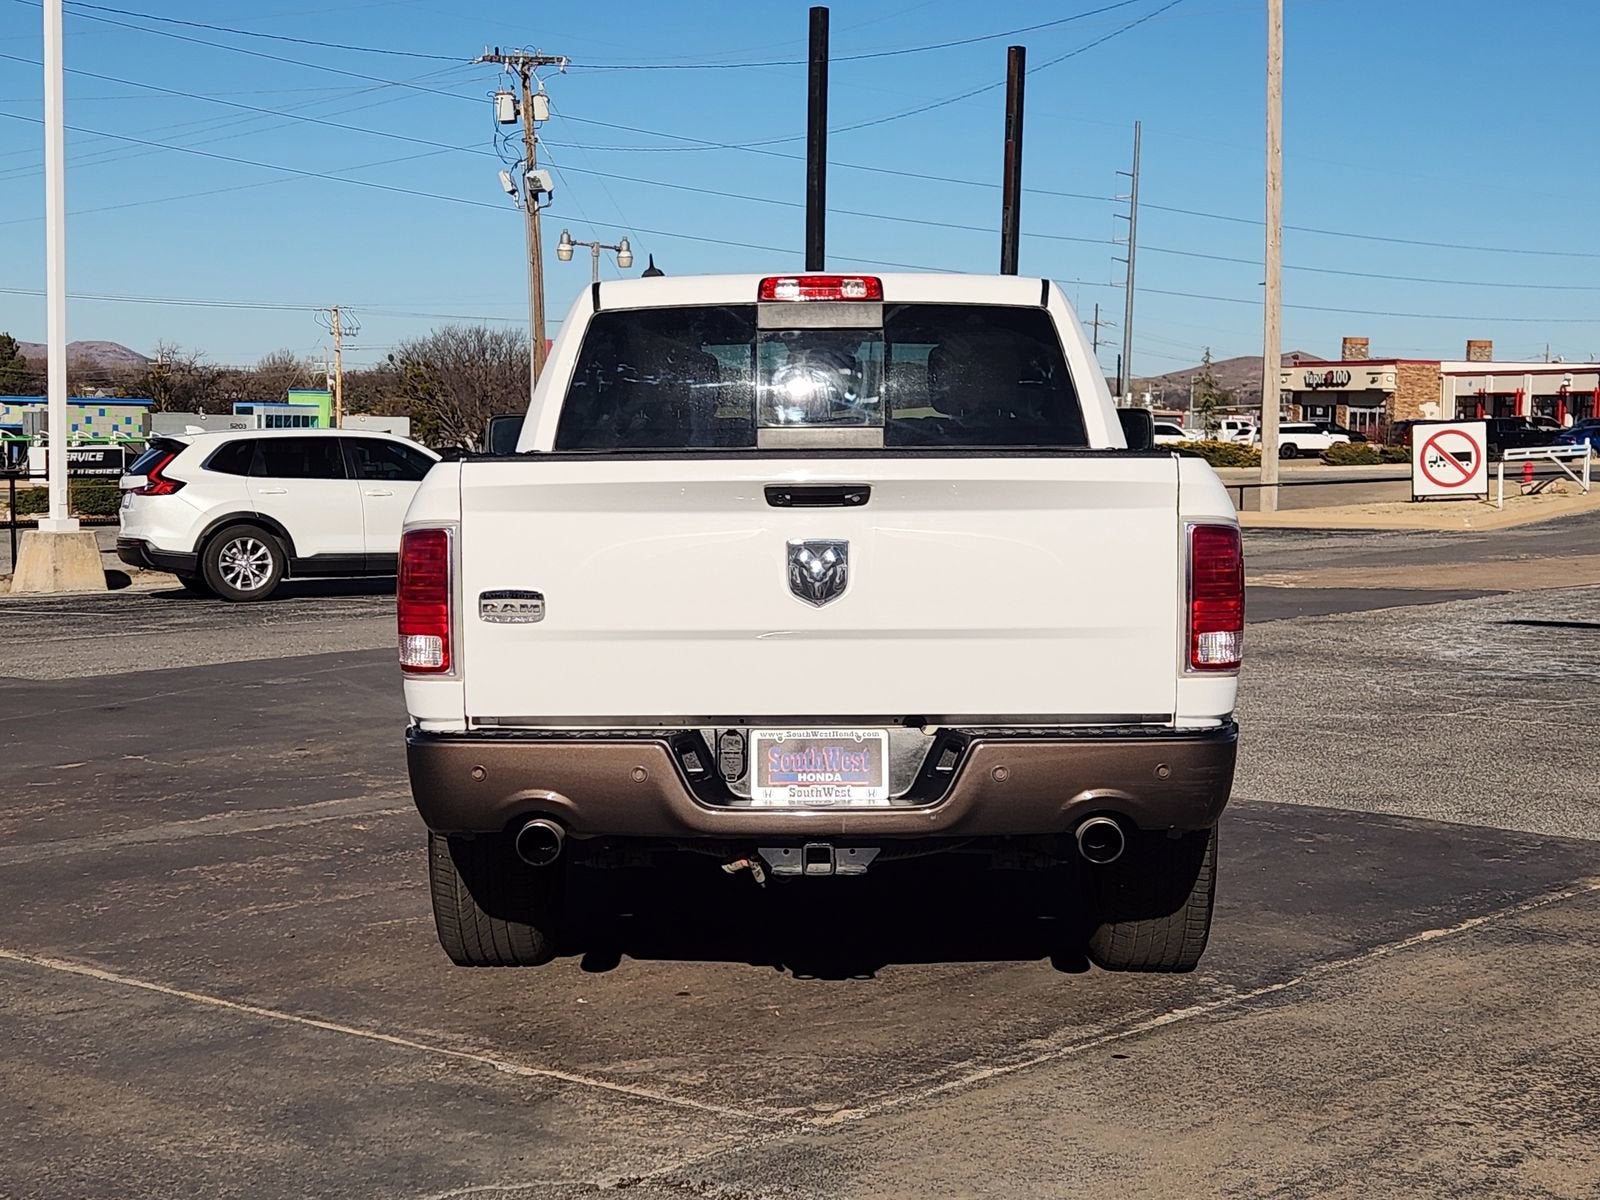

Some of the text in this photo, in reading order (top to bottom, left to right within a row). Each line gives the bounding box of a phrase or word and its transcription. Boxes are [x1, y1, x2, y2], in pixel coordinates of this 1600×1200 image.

[1304, 369, 1350, 388] Vapor 100
[66, 451, 105, 462] ERVICE
[482, 603, 541, 614] RAM
[767, 745, 871, 773] SouthWest
[797, 772, 843, 782] HONDA
[789, 787, 852, 798] SouthWest
